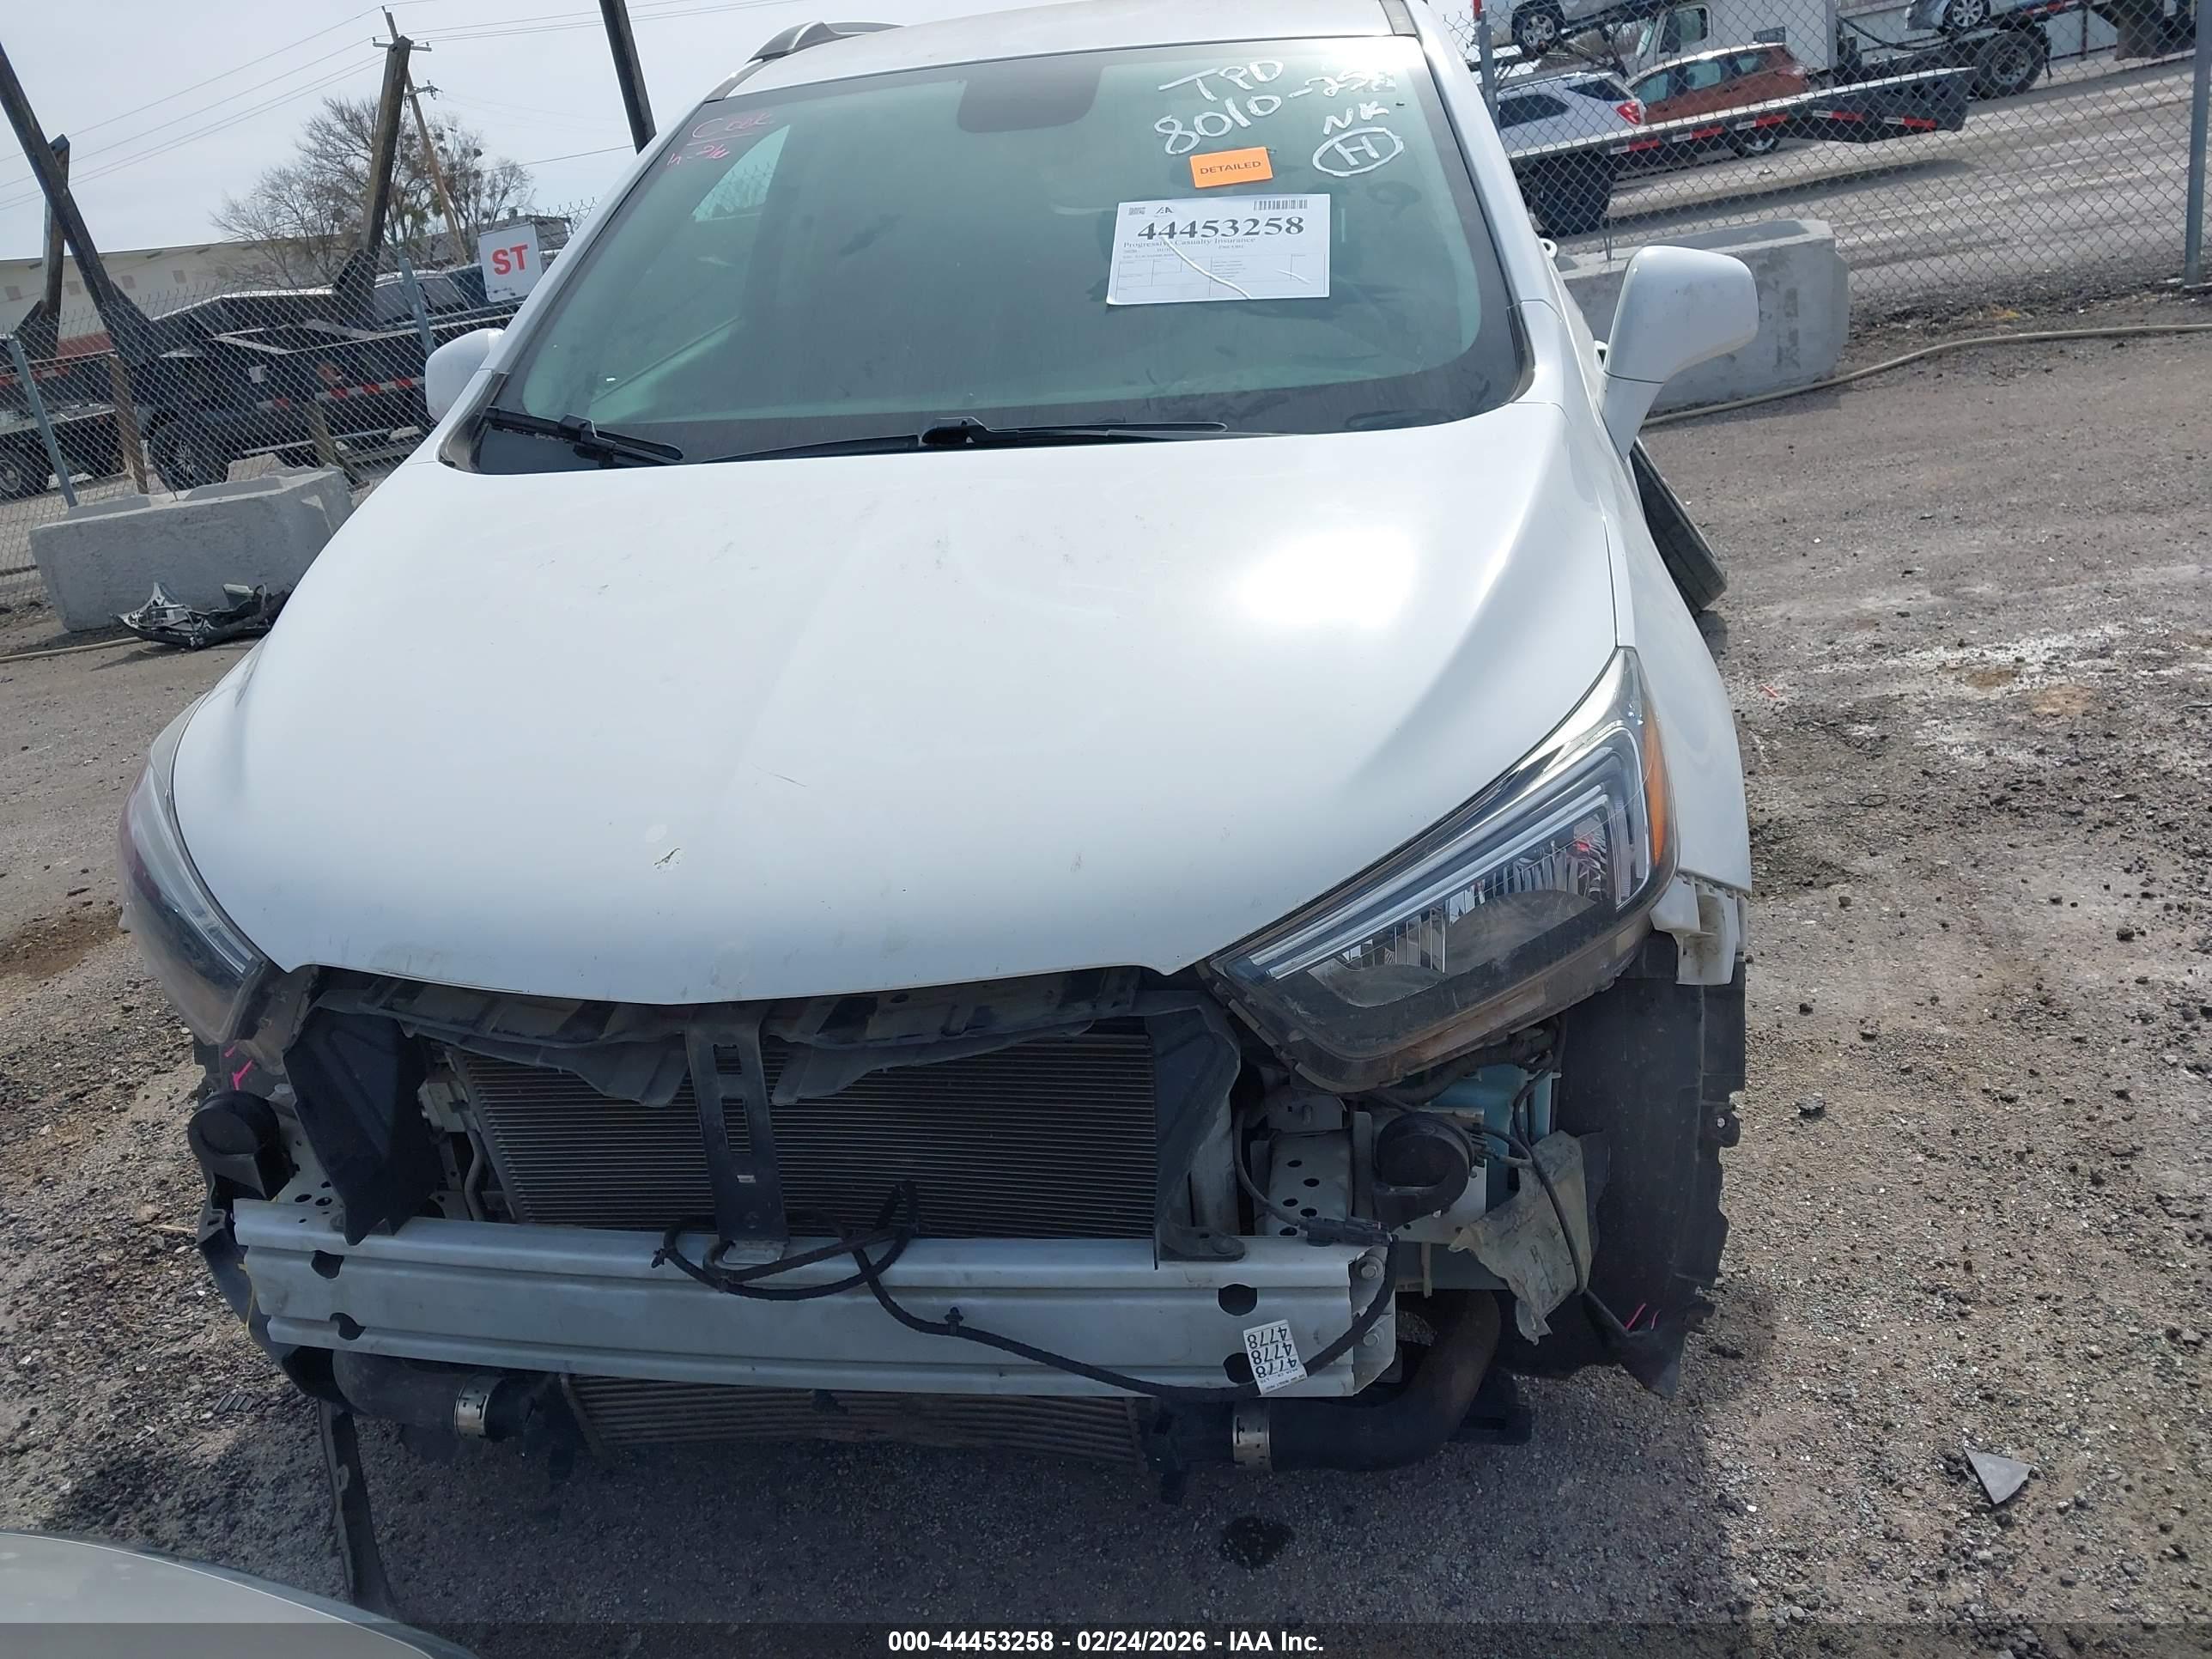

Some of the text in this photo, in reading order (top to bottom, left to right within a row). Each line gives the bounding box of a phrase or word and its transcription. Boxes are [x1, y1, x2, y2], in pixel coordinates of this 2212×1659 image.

[1158, 60, 1284, 101] TPD
[1200, 161, 1261, 175] DETAILED
[1137, 216, 1304, 240] 44453258
[1175, 237, 1212, 246] Casualty
[1214, 236, 1256, 245] Insurance
[492, 244, 528, 275] ST
[1247, 1327, 1287, 1349] 4778
[1251, 1342, 1292, 1364] 4778
[1255, 1358, 1297, 1378] 4778
